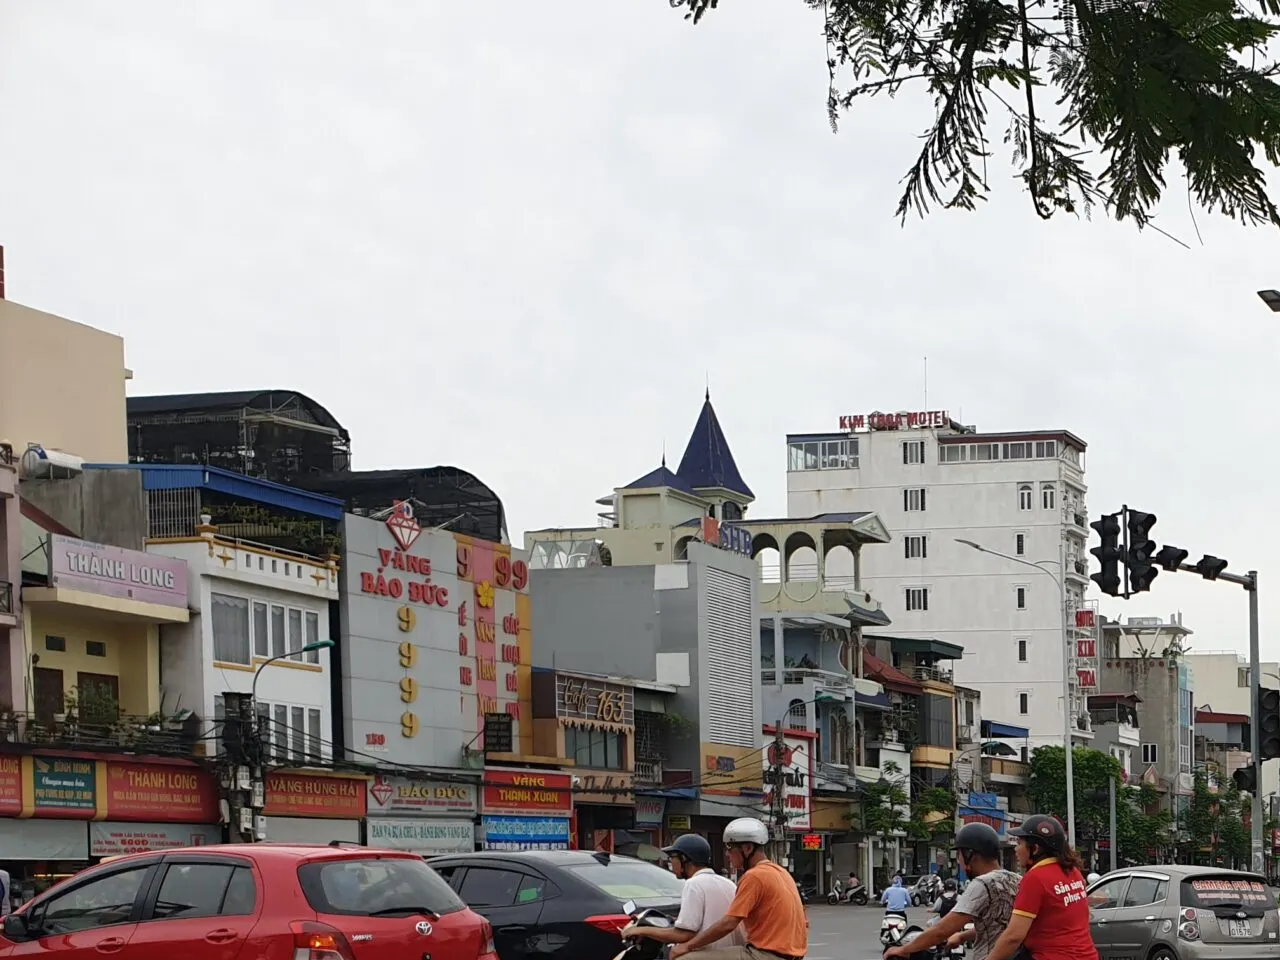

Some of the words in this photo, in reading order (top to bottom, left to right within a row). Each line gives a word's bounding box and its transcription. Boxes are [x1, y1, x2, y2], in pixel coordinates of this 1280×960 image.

[839, 415, 864, 429] KIM
[907, 411, 949, 426] MOTEL
[378, 546, 431, 575] VÀNG
[66, 551, 126, 580] THÀNH
[130, 563, 175, 589] LONG
[408, 578, 448, 607] ĐỨC
[1077, 640, 1095, 657] KIM
[1076, 670, 1096, 687] THOA
[596, 692, 625, 723] 163
[168, 774, 197, 789] LONG
[270, 777, 302, 793] VÀNG
[512, 773, 545, 786] VÀNG
[500, 789, 530, 802] THANH
